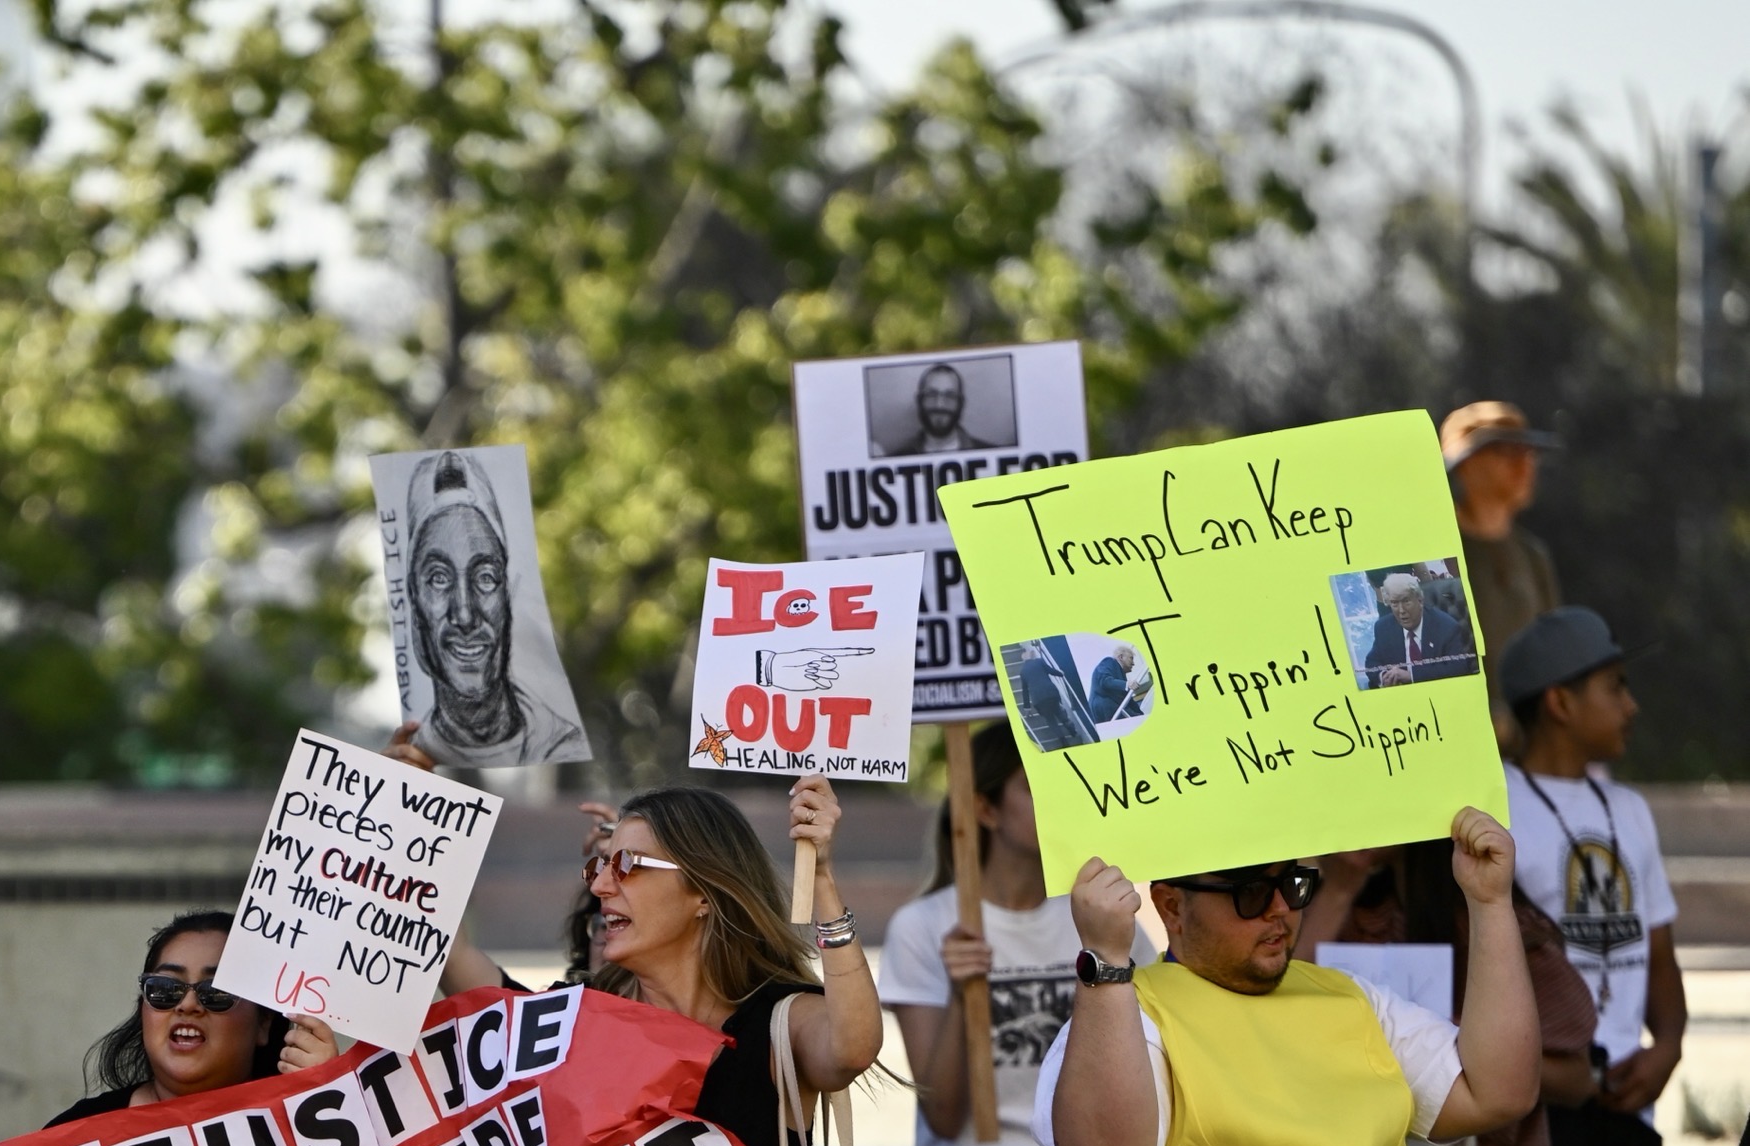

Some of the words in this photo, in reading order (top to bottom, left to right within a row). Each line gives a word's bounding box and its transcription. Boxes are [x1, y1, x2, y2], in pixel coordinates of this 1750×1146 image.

[381, 508, 401, 564] ICE
[972, 484, 1172, 603] Trump
[1163, 469, 1257, 556] Can
[1248, 458, 1354, 565] Keep
[712, 568, 879, 637] ICE
[389, 578, 412, 712] ABOLISH
[725, 684, 873, 753] OUT
[301, 736, 385, 820] They
[401, 782, 492, 837] want
[724, 747, 824, 774] HEALING,
[826, 755, 858, 773] NOT
[861, 758, 906, 781] HARM
[1063, 739, 1207, 817] We're
[1226, 731, 1295, 785] Not
[1312, 696, 1444, 777] Slippin!
[265, 828, 314, 874] my
[276, 790, 394, 851] pieces
[406, 836, 452, 867] of
[250, 858, 277, 896] in
[288, 874, 352, 921] their
[240, 895, 309, 949] but
[336, 940, 422, 994] NOT
